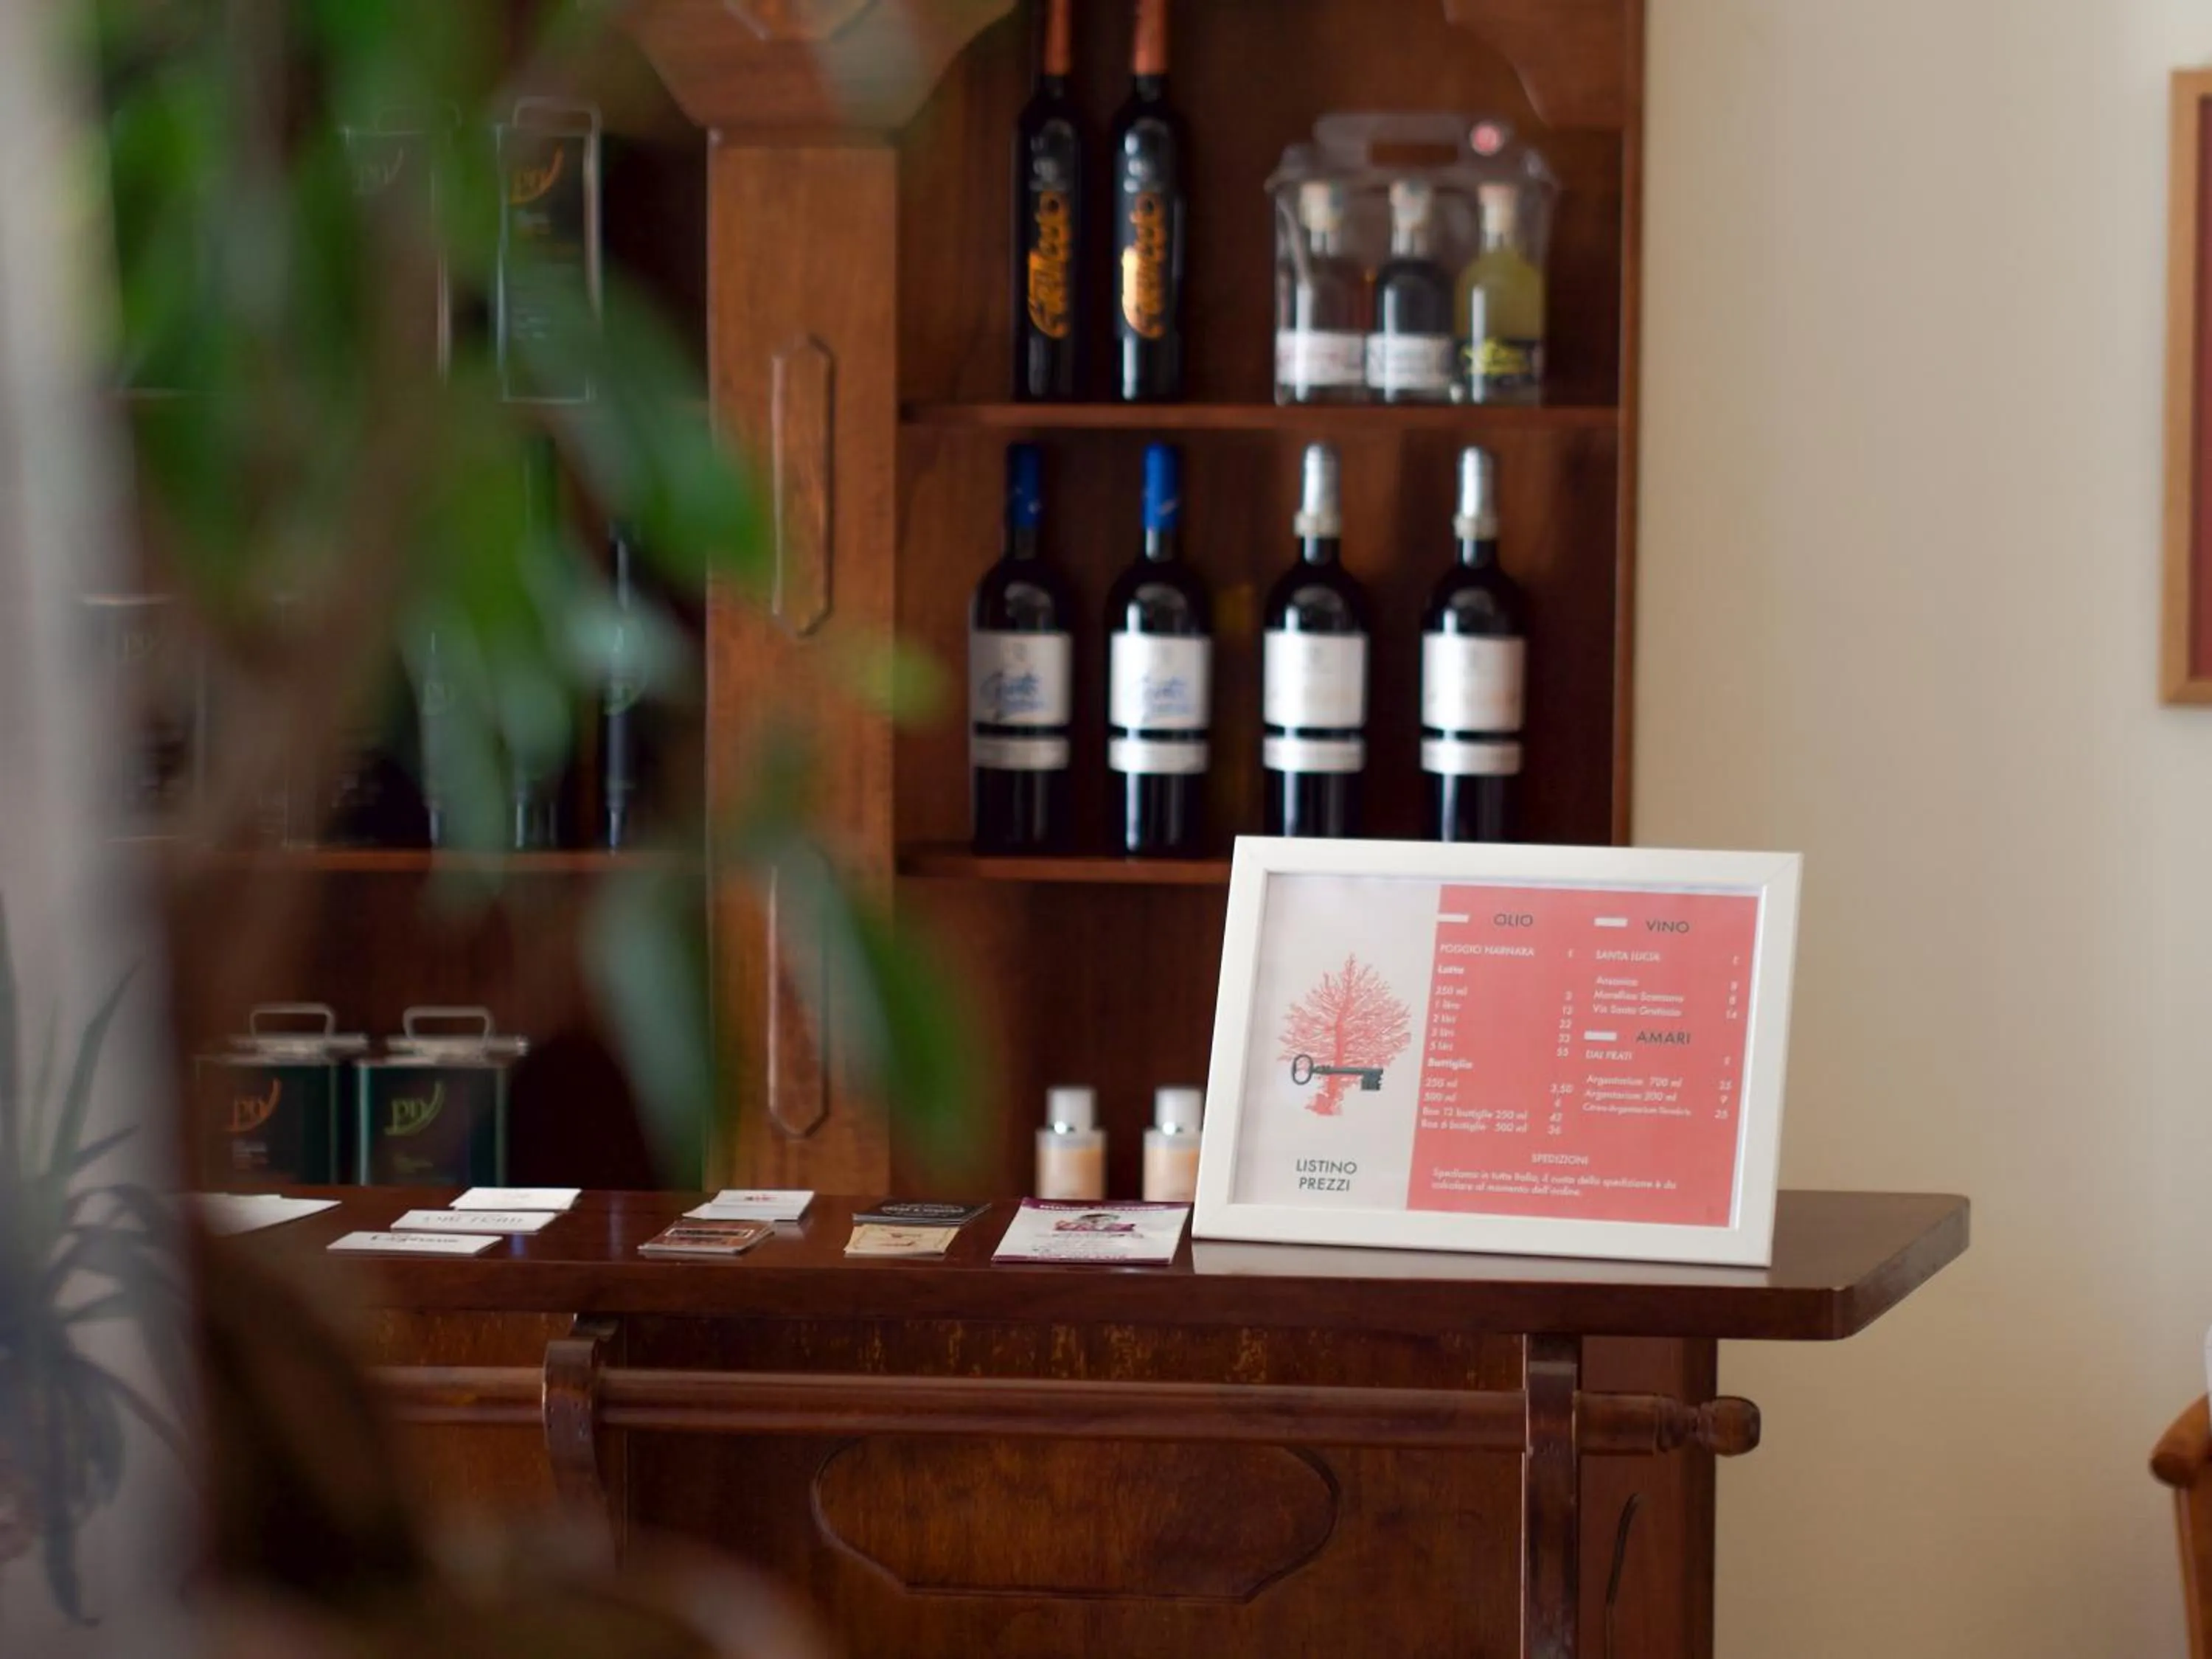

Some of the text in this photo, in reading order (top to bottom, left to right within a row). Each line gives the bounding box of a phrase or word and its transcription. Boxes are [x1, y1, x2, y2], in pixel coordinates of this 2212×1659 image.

[1494, 914, 1534, 927] OLIO
[1646, 920, 1690, 933] VINO
[1440, 944, 1481, 955] POGGIO
[1596, 950, 1628, 961] SANTA
[1630, 951, 1660, 961] LUCIA
[1435, 986, 1454, 995] 250
[1455, 985, 1468, 995] ml
[1635, 1032, 1691, 1045] AMARI
[1425, 1079, 1444, 1088] 250
[1447, 1078, 1458, 1088] ml
[1444, 1092, 1457, 1102] ml
[1295, 1159, 1357, 1175] LISTINO
[1298, 1177, 1350, 1192] PREZZI
